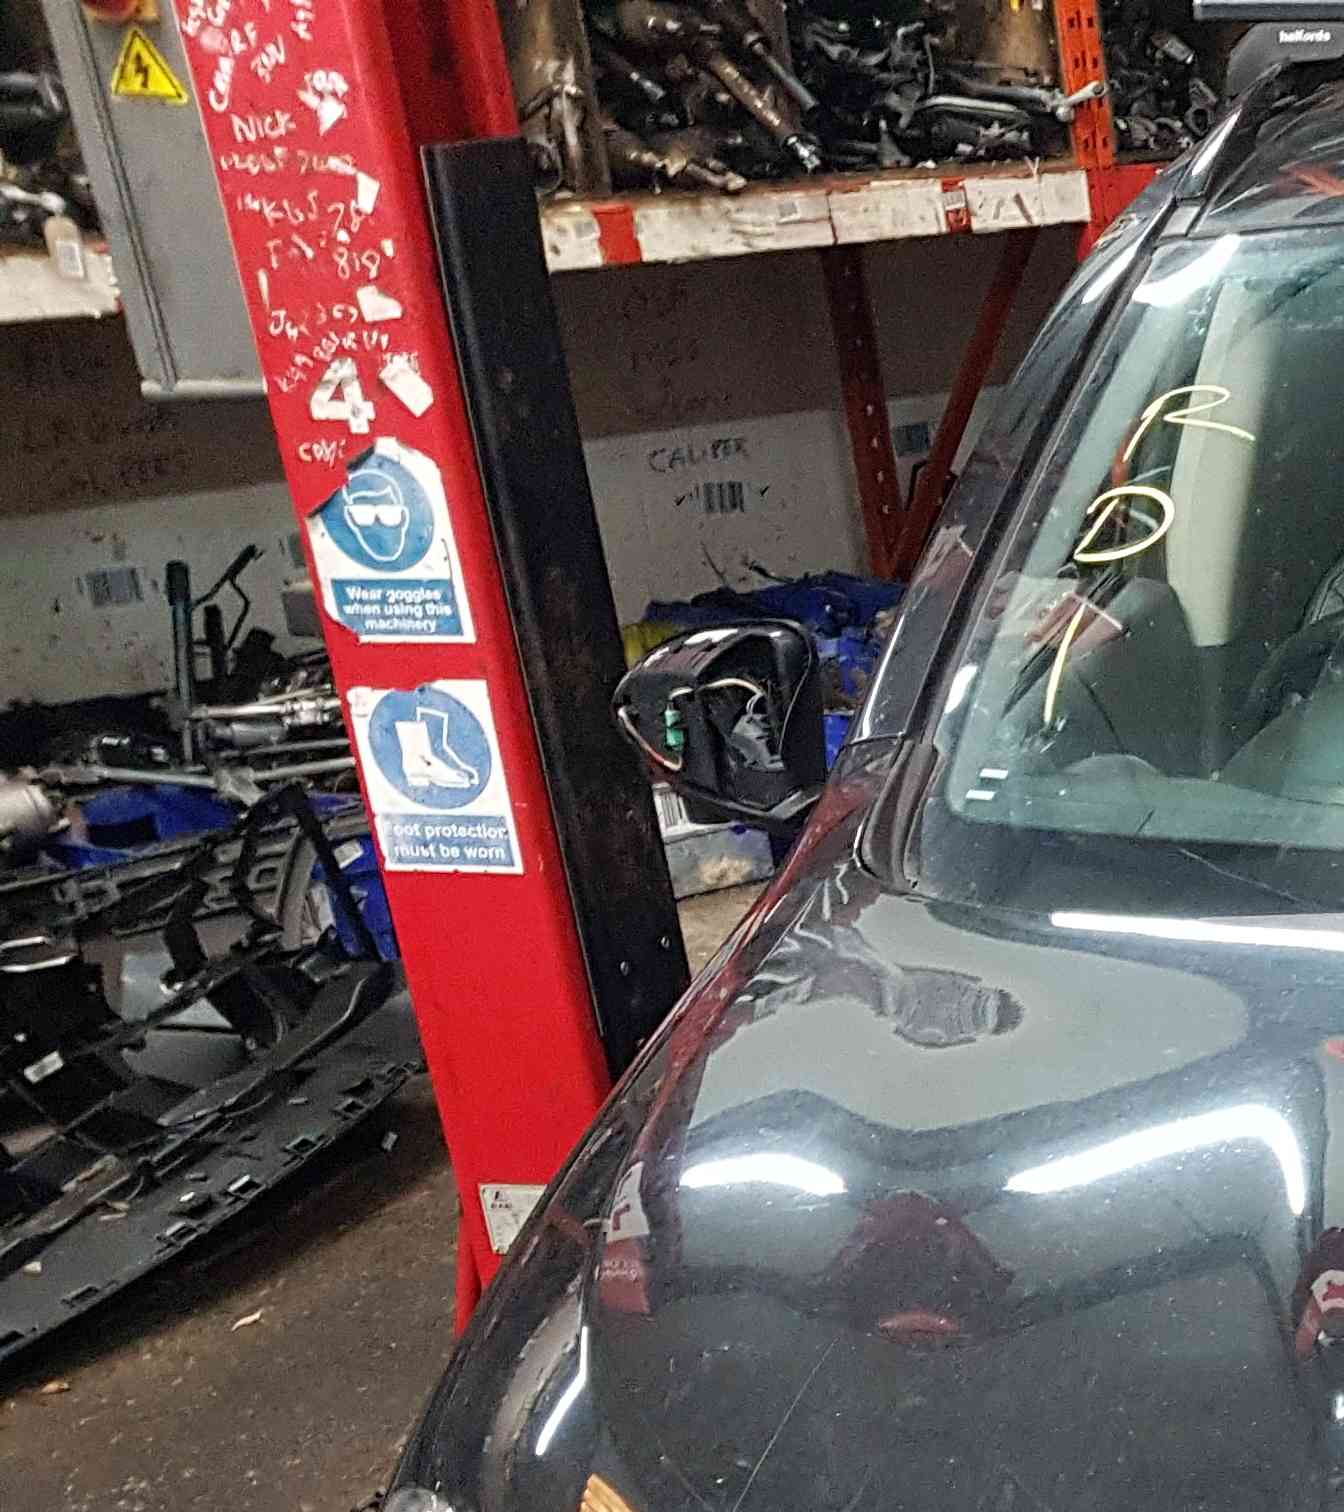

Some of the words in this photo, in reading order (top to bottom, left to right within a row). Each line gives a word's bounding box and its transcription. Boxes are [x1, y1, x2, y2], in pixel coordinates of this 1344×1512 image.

[310, 357, 376, 434] 4
[345, 586, 382, 600] Wear
[386, 587, 442, 603] goggles
[343, 603, 381, 615] when
[384, 603, 423, 617] using
[425, 602, 453, 616] this
[364, 618, 437, 633] machinery
[384, 823, 419, 838] oot
[394, 844, 435, 859] must
[439, 844, 460, 858] be
[463, 845, 506, 858] worn
